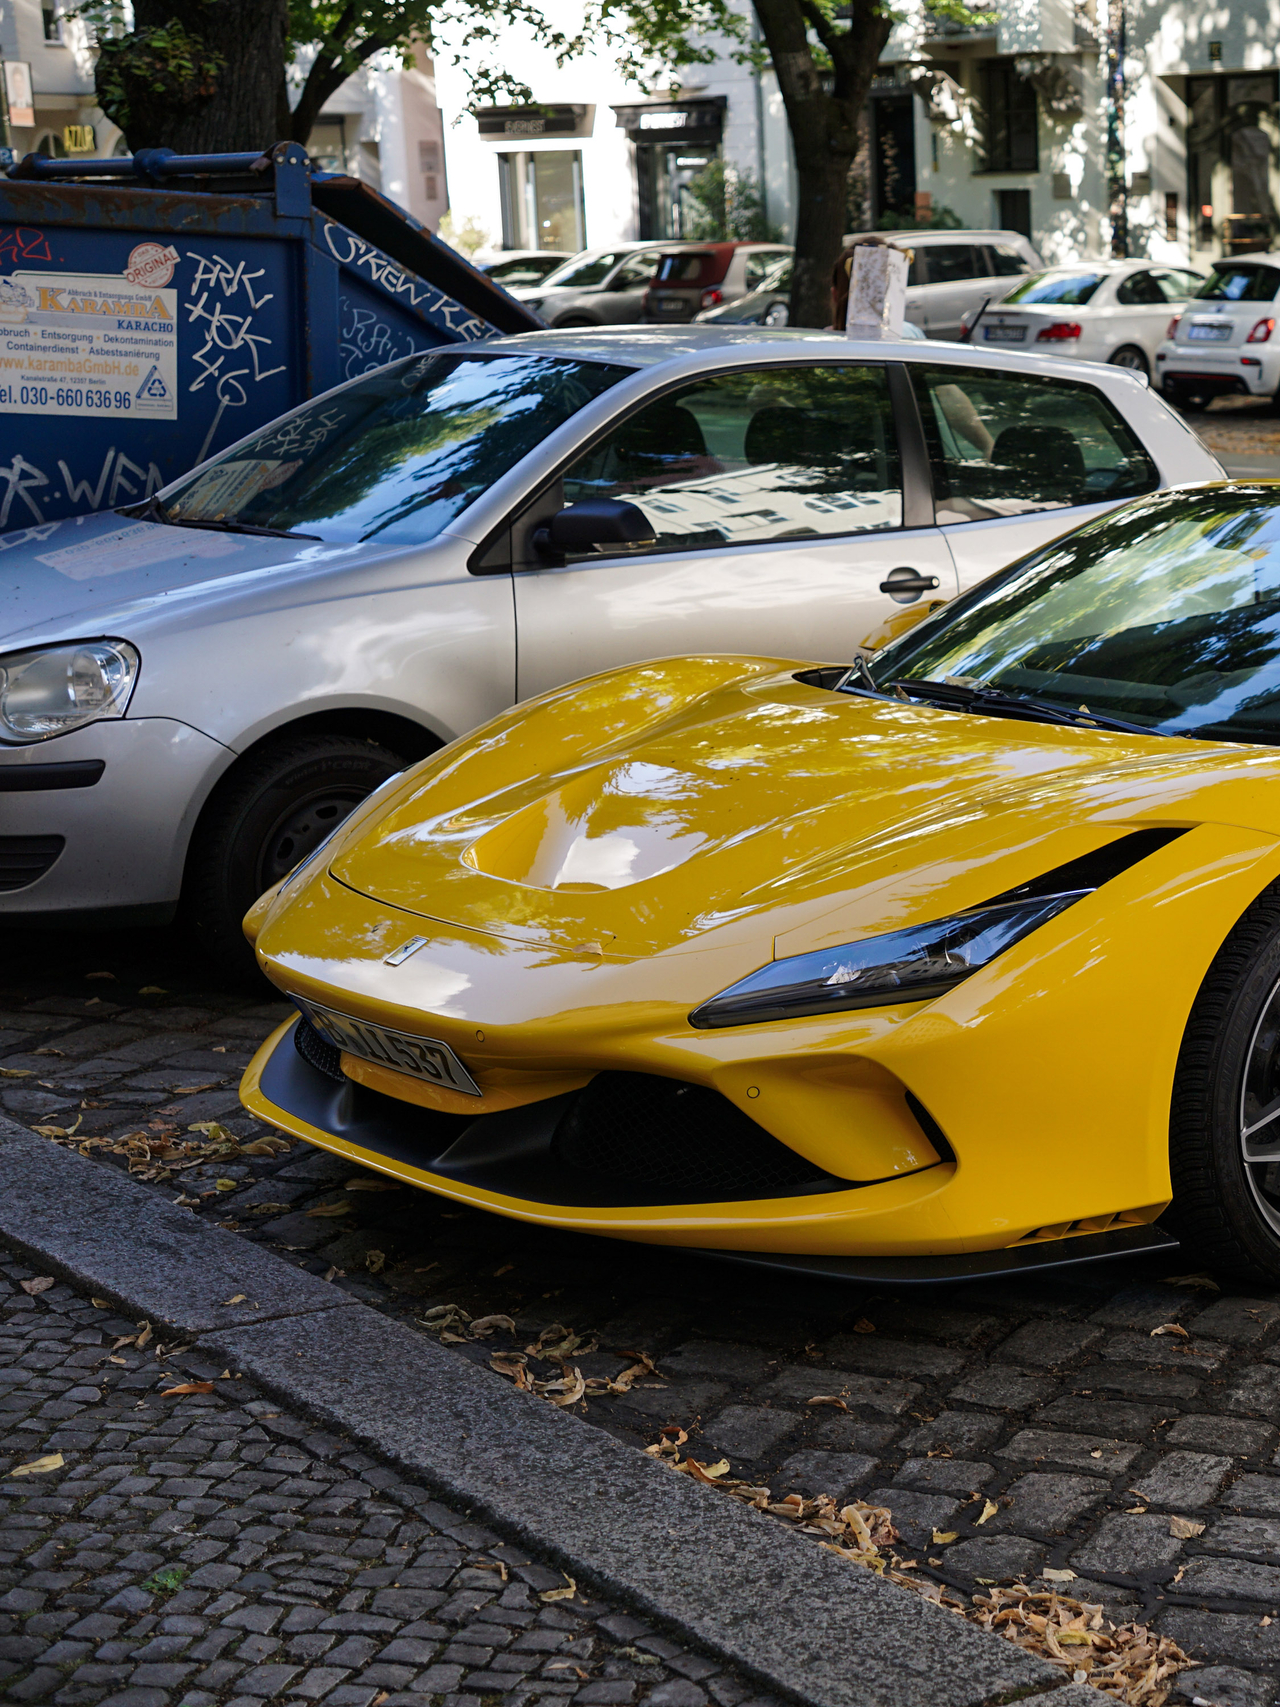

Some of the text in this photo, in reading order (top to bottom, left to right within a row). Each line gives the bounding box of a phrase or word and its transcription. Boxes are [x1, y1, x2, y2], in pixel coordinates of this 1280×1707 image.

[126, 250, 179, 283] ORIGINAL
[67, 289, 92, 298] Abbruch
[36, 286, 174, 320] KARAMBA
[117, 319, 174, 333] KARACHO
[6, 341, 79, 355] Containerdienst
[41, 330, 94, 343] Entsorgung
[103, 334, 174, 348] Dekontamination
[88, 378, 107, 386] Berlin
[0, 384, 18, 405] el.
[310, 1007, 349, 1047] B
[384, 1033, 459, 1086] 537
